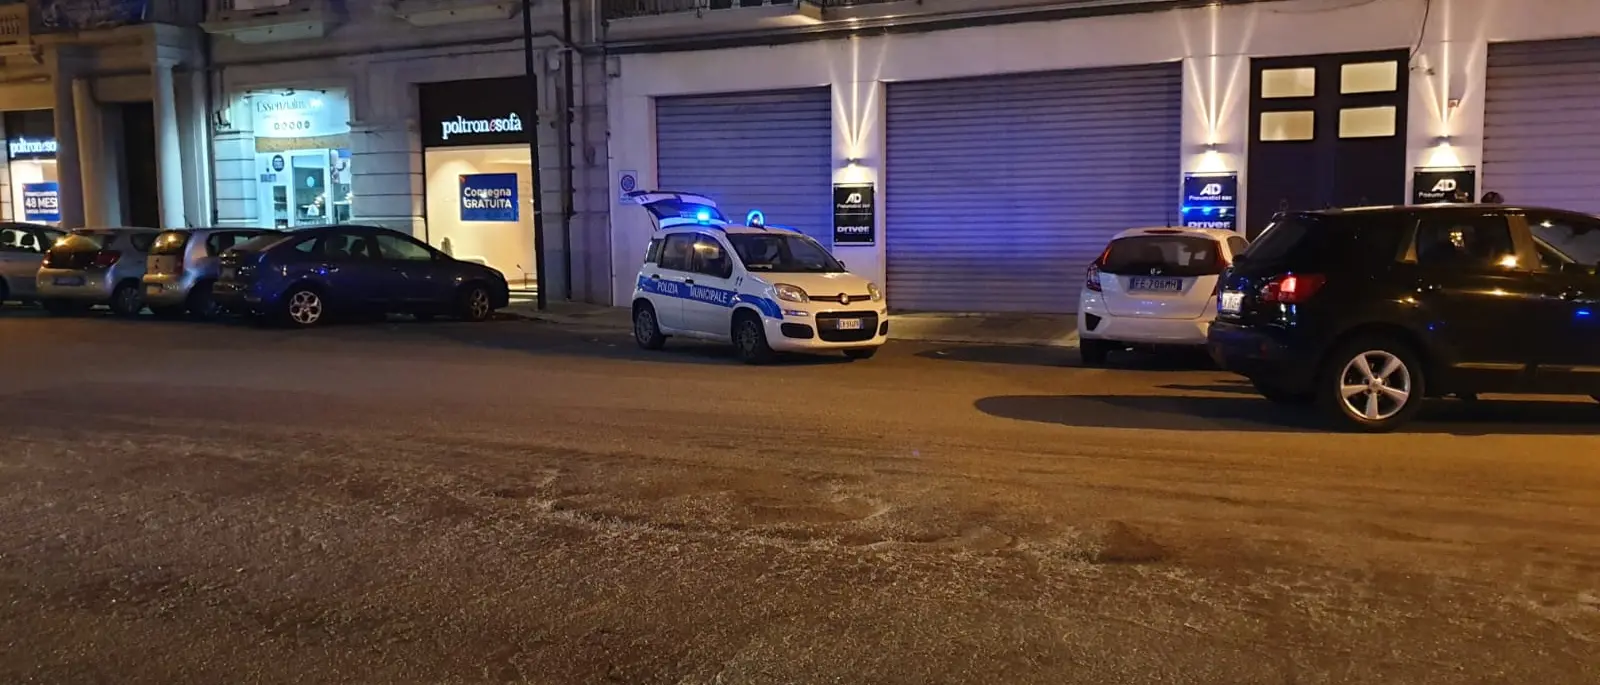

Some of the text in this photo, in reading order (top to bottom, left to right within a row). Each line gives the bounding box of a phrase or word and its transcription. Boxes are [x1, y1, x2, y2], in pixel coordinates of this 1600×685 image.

[9, 137, 57, 158] poltroneso
[1199, 183, 1222, 196] AD
[1431, 178, 1457, 192] AD
[464, 186, 512, 199] Consegna
[845, 192, 862, 204] AD
[25, 197, 58, 208] 48 MESI
[464, 197, 513, 209] GRATUITA
[656, 281, 728, 303] POLIZIA MUNICIPALE
